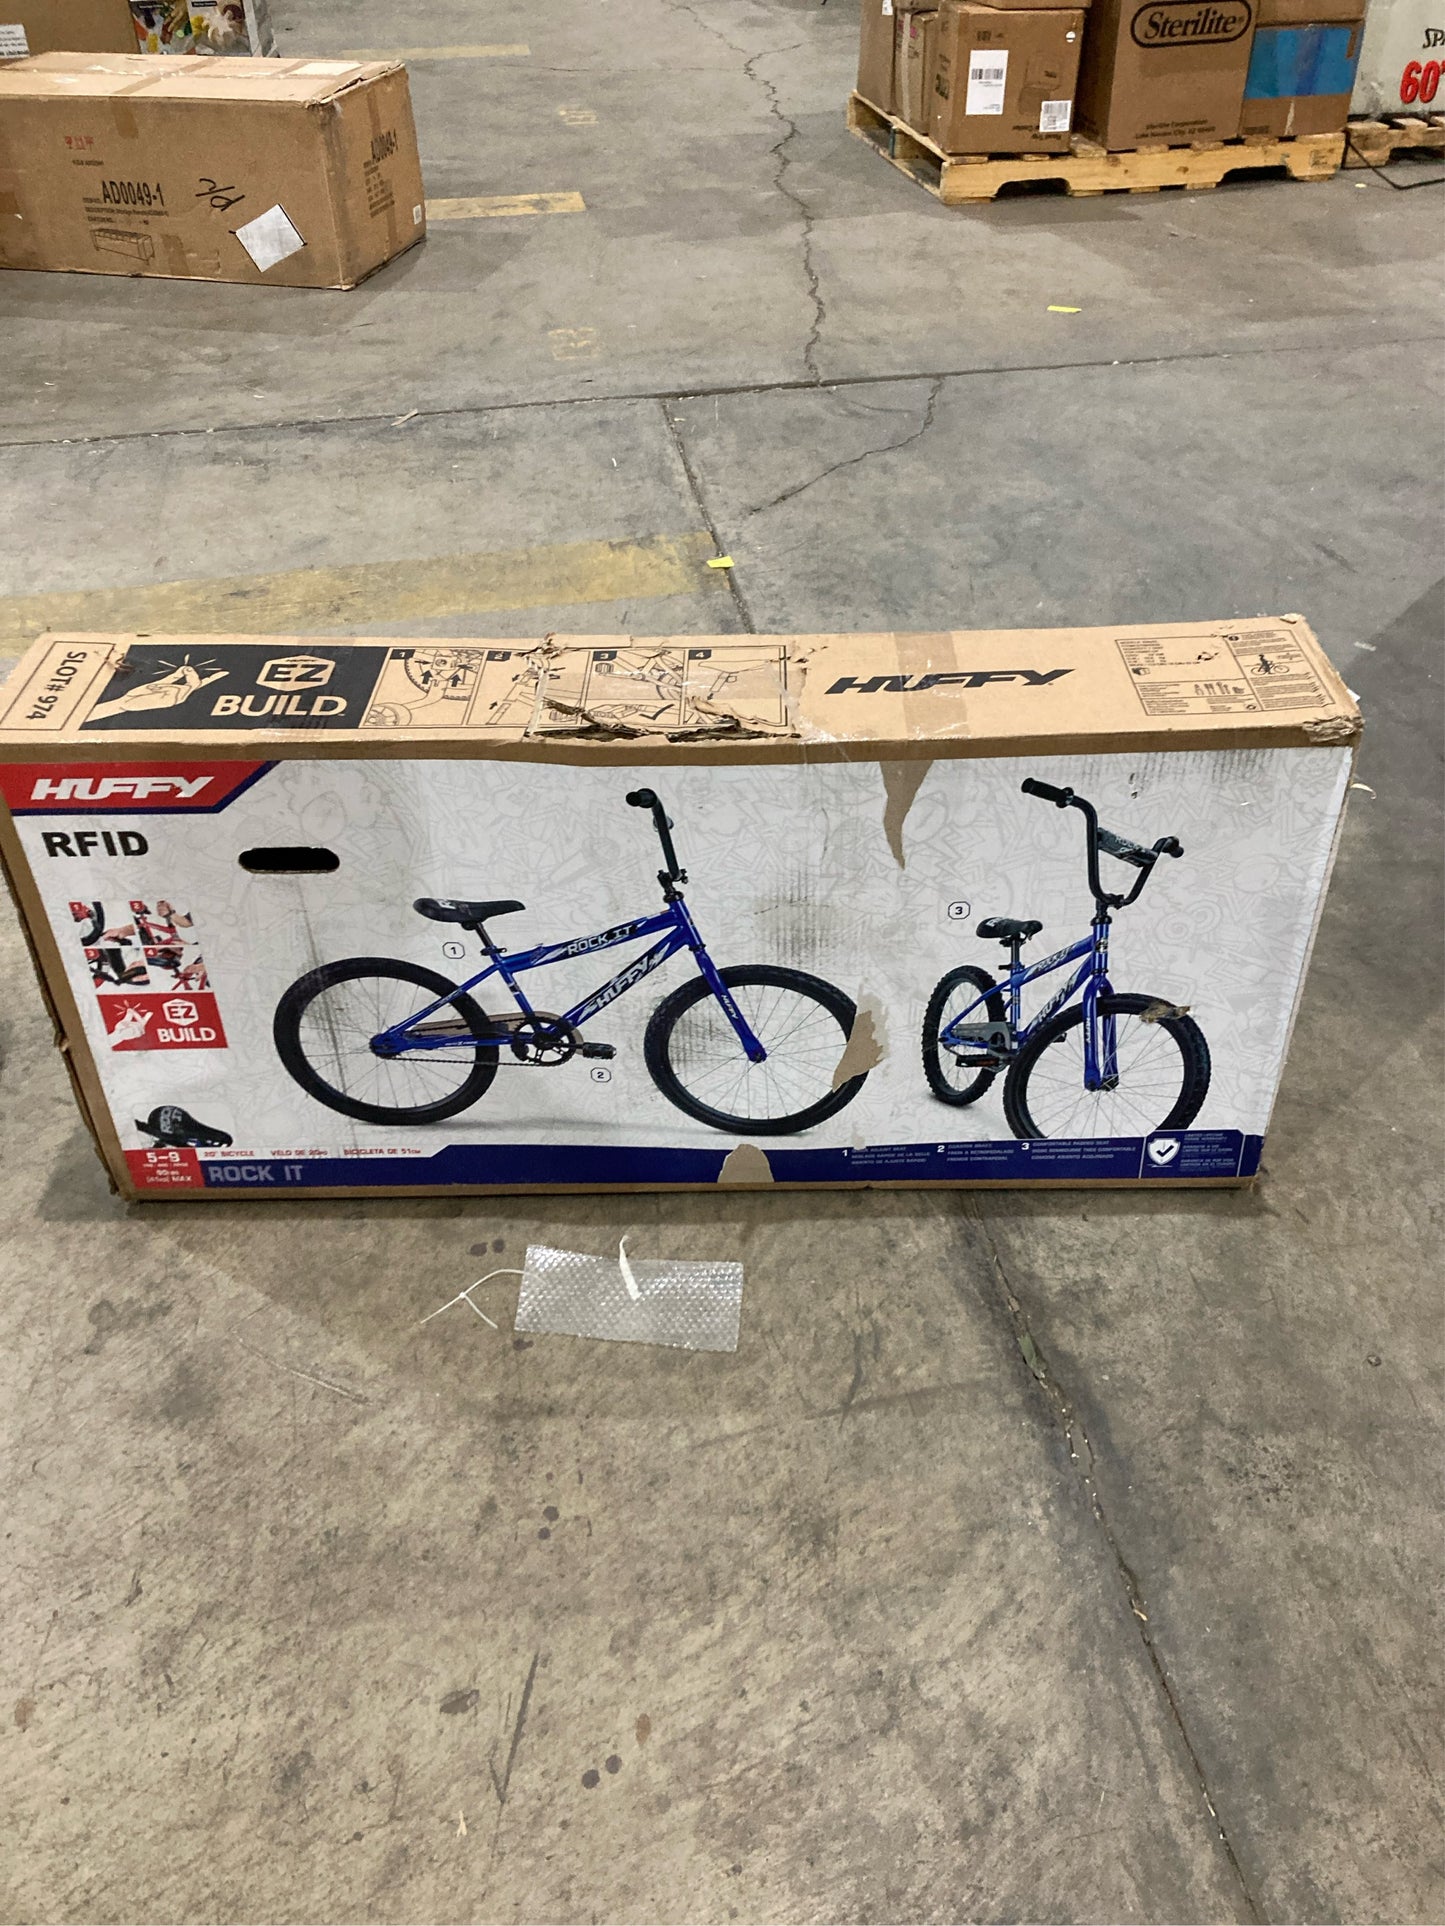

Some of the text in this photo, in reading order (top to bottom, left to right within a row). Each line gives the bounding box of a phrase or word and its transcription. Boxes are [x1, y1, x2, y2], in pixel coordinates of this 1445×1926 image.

[1144, 8, 1237, 39] Sterilite
[102, 180, 165, 207] AD0049-1
[263, 664, 329, 682] EZ
[824, 669, 1076, 694] HUFFY
[25, 695, 59, 720] 974
[210, 694, 347, 716] BUILD
[31, 776, 215, 800] HUFFY
[41, 831, 149, 857] RFID
[955, 906, 963, 915] 3
[567, 926, 632, 956] ROCK IT
[596, 956, 649, 1008] HUFFY
[166, 1005, 195, 1019] EZ
[157, 1027, 216, 1042] BUILD
[597, 1071, 605, 1080] 2
[842, 1149, 848, 1157] 1
[937, 1145, 945, 1153] 2
[1021, 1142, 1030, 1150] 3
[208, 1165, 303, 1183] ROCK IT
